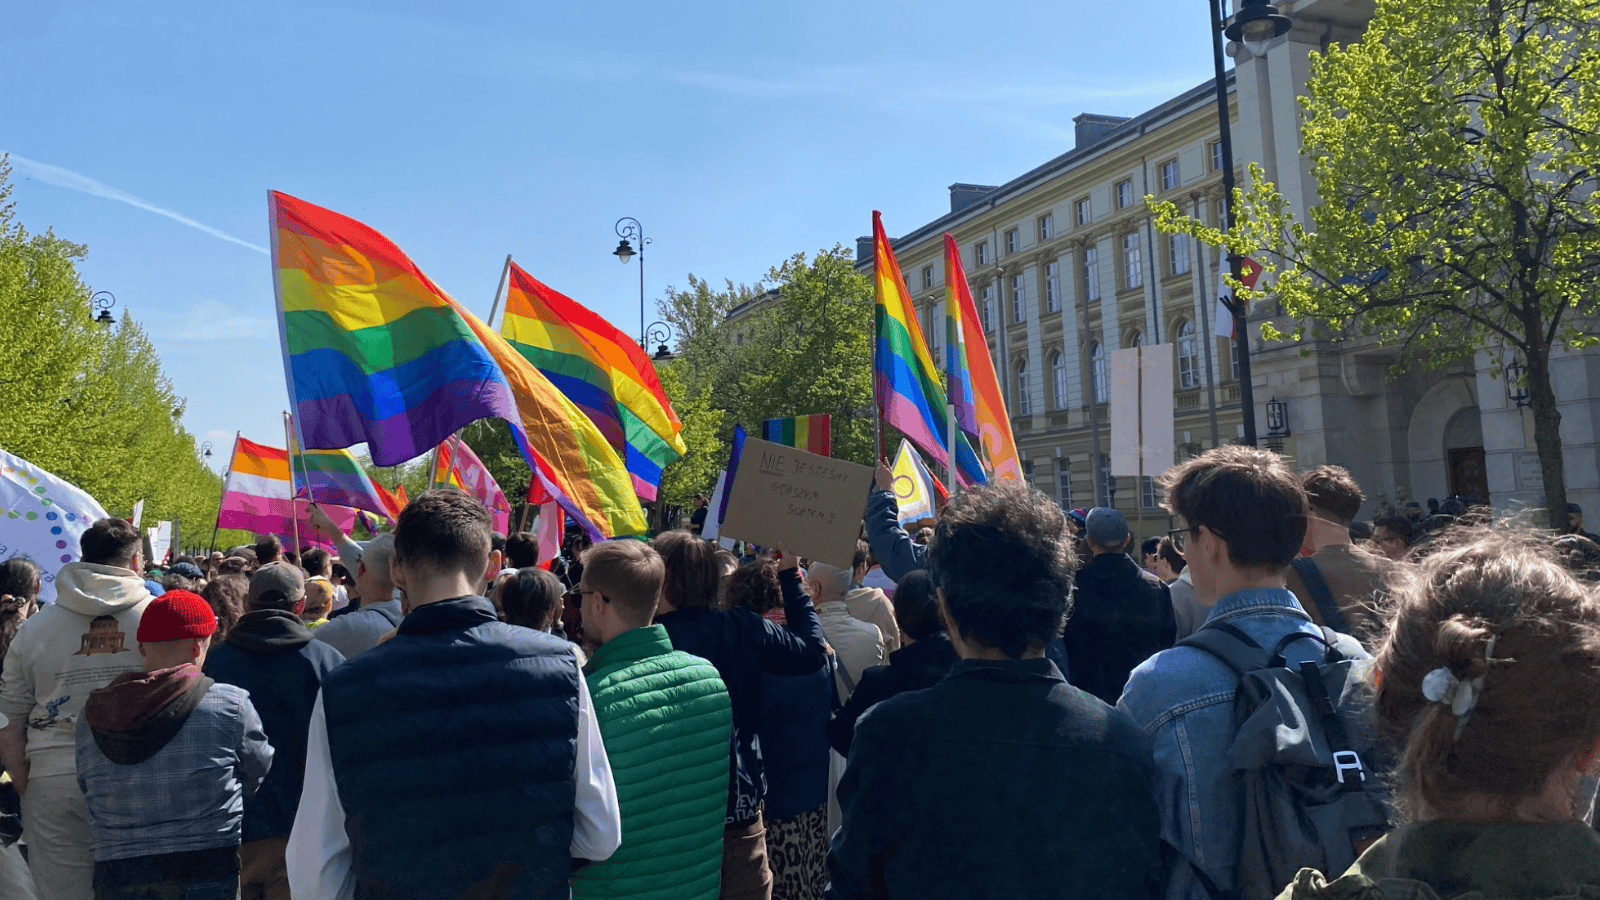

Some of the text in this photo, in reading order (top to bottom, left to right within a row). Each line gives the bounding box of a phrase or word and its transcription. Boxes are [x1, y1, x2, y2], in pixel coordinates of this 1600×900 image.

[760, 451, 848, 482] NIE JESTEŚMY
[771, 482, 819, 502] GORSZYM
